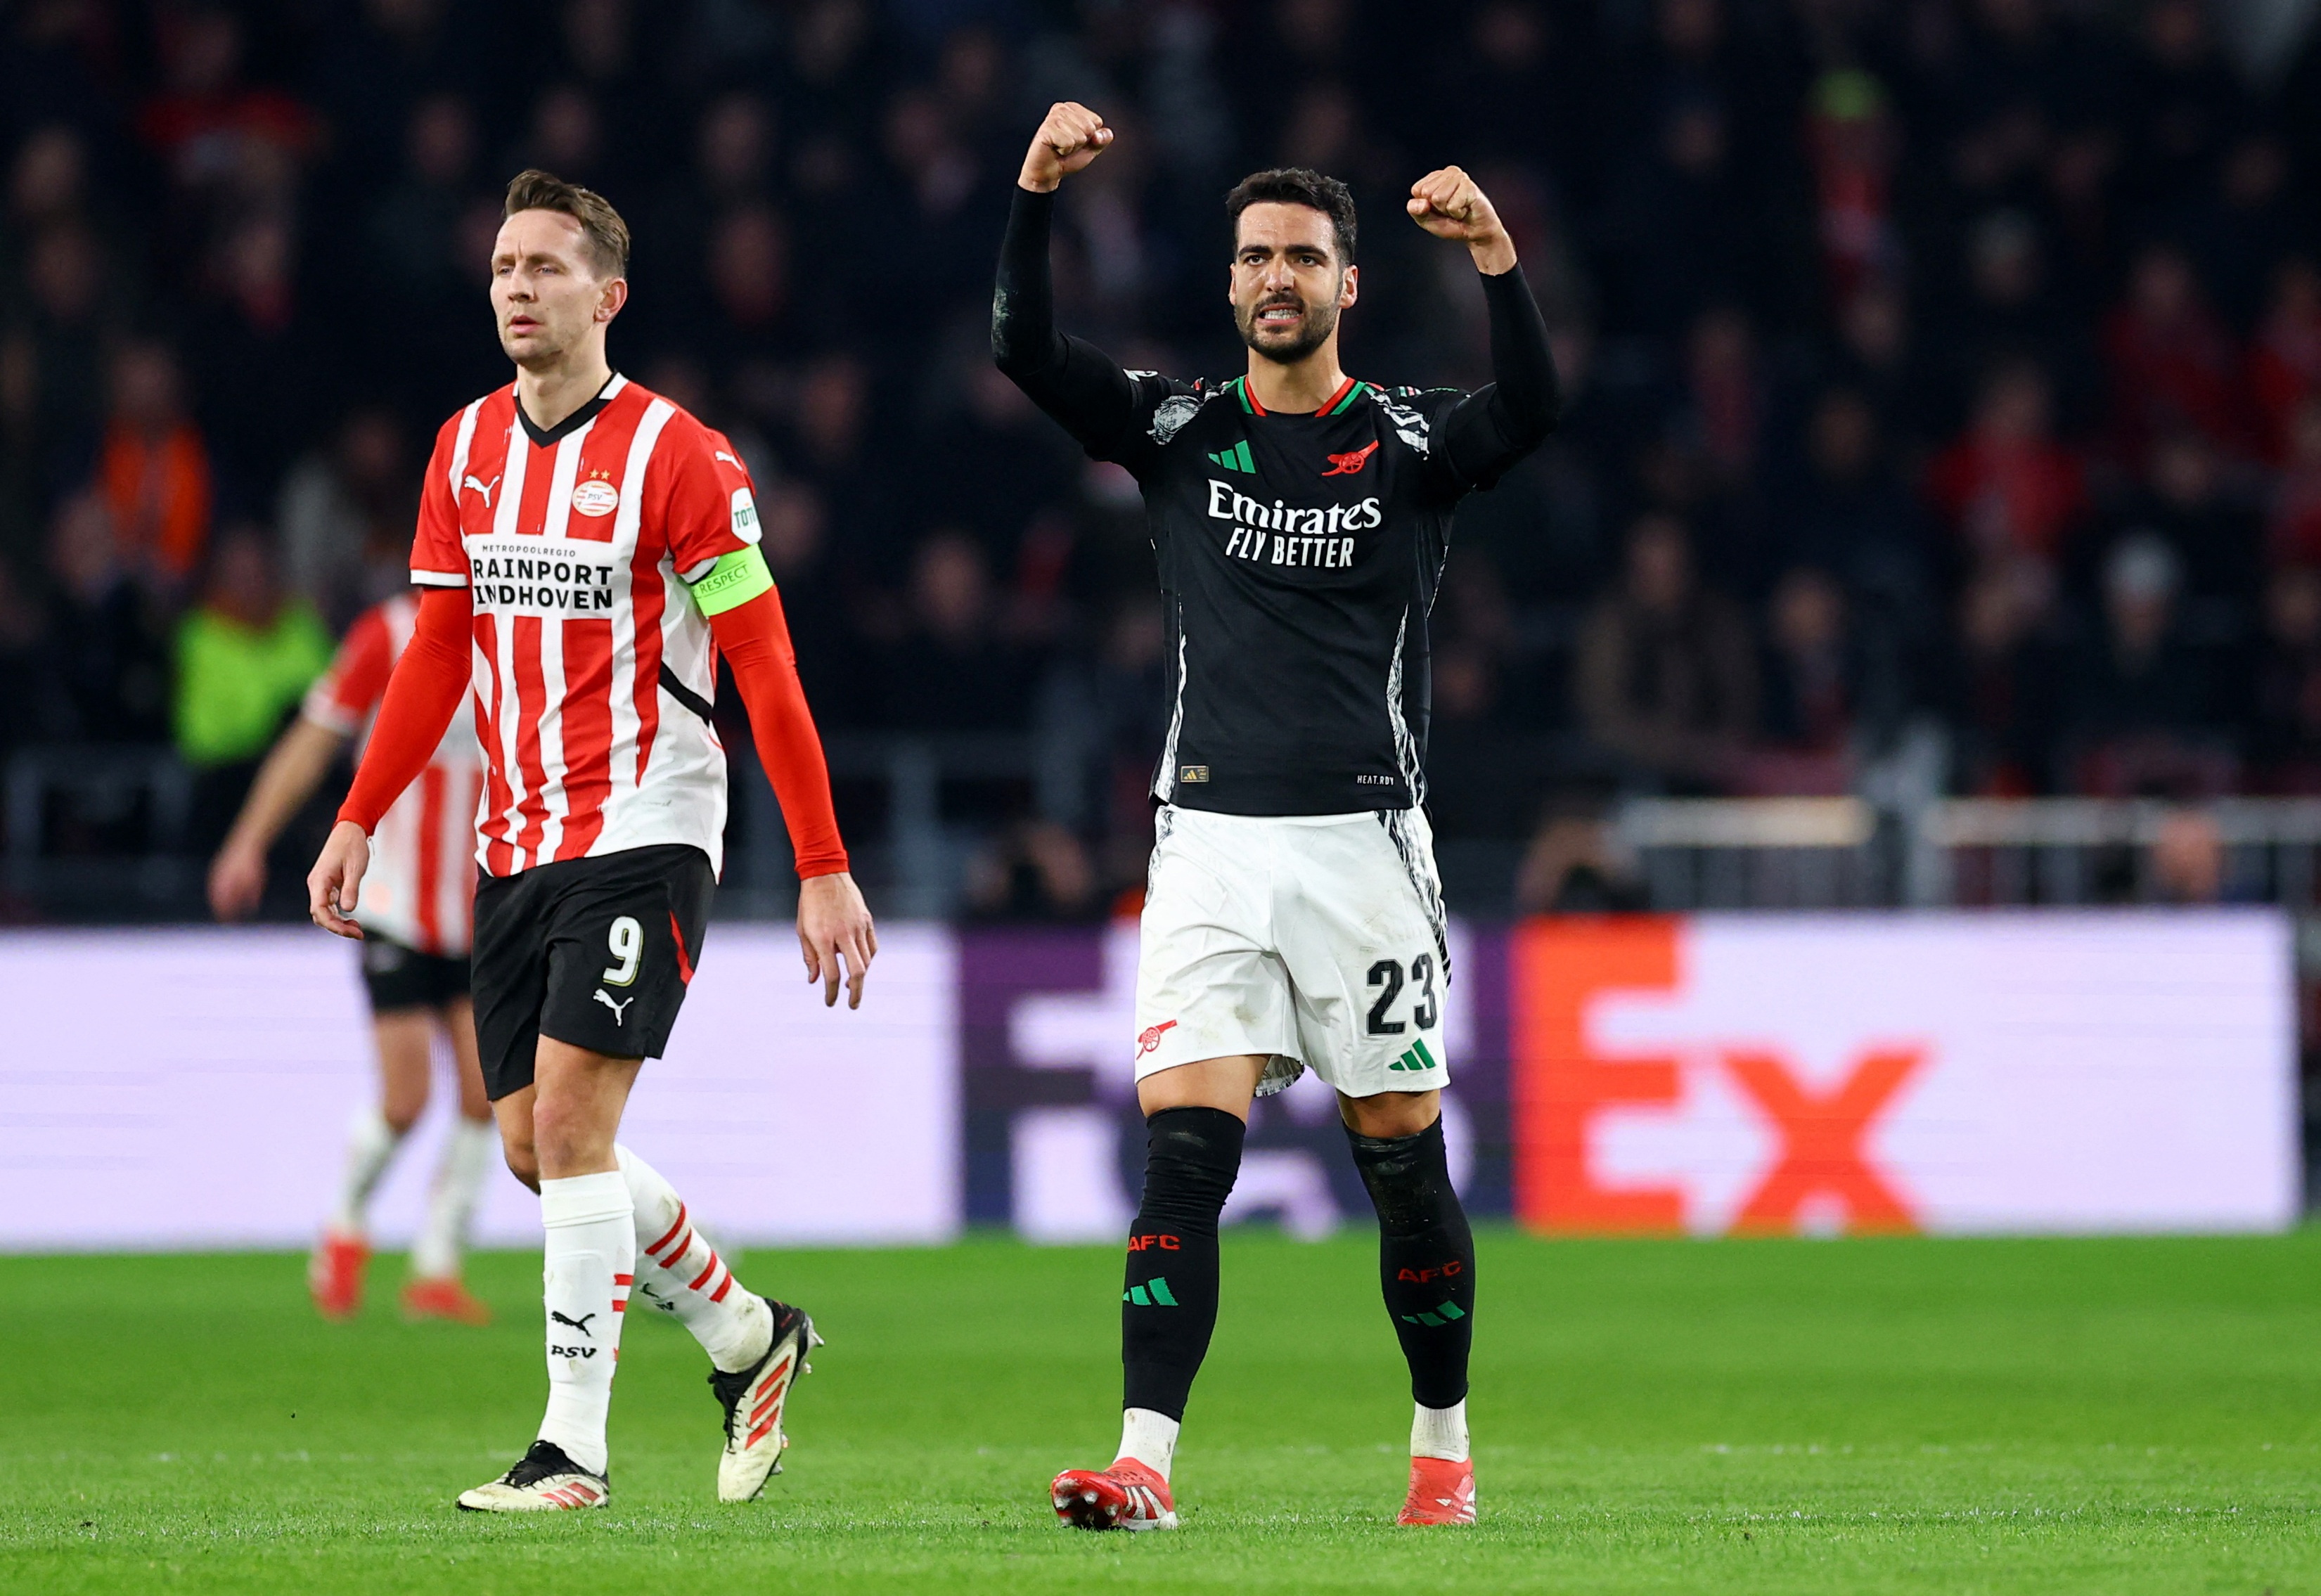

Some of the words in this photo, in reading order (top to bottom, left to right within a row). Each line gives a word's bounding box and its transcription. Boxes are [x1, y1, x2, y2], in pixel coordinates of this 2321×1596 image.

[586, 493, 603, 501] PSV
[1208, 479, 1382, 534] Emirates
[482, 545, 576, 557] METROPOOLREGIO
[1226, 527, 1266, 561] FLY
[1271, 536, 1354, 567] BETTER
[472, 558, 613, 585] RAINPORT
[699, 564, 747, 594] RESPECT
[474, 584, 612, 610] INDHOVEN
[1357, 775, 1394, 785] HEAT.RDY
[603, 916, 643, 987] 9
[1367, 952, 1437, 1036] 23
[1127, 1235, 1180, 1252] AFC
[1398, 1261, 1462, 1283] AFC
[551, 1344, 596, 1358] PSV
